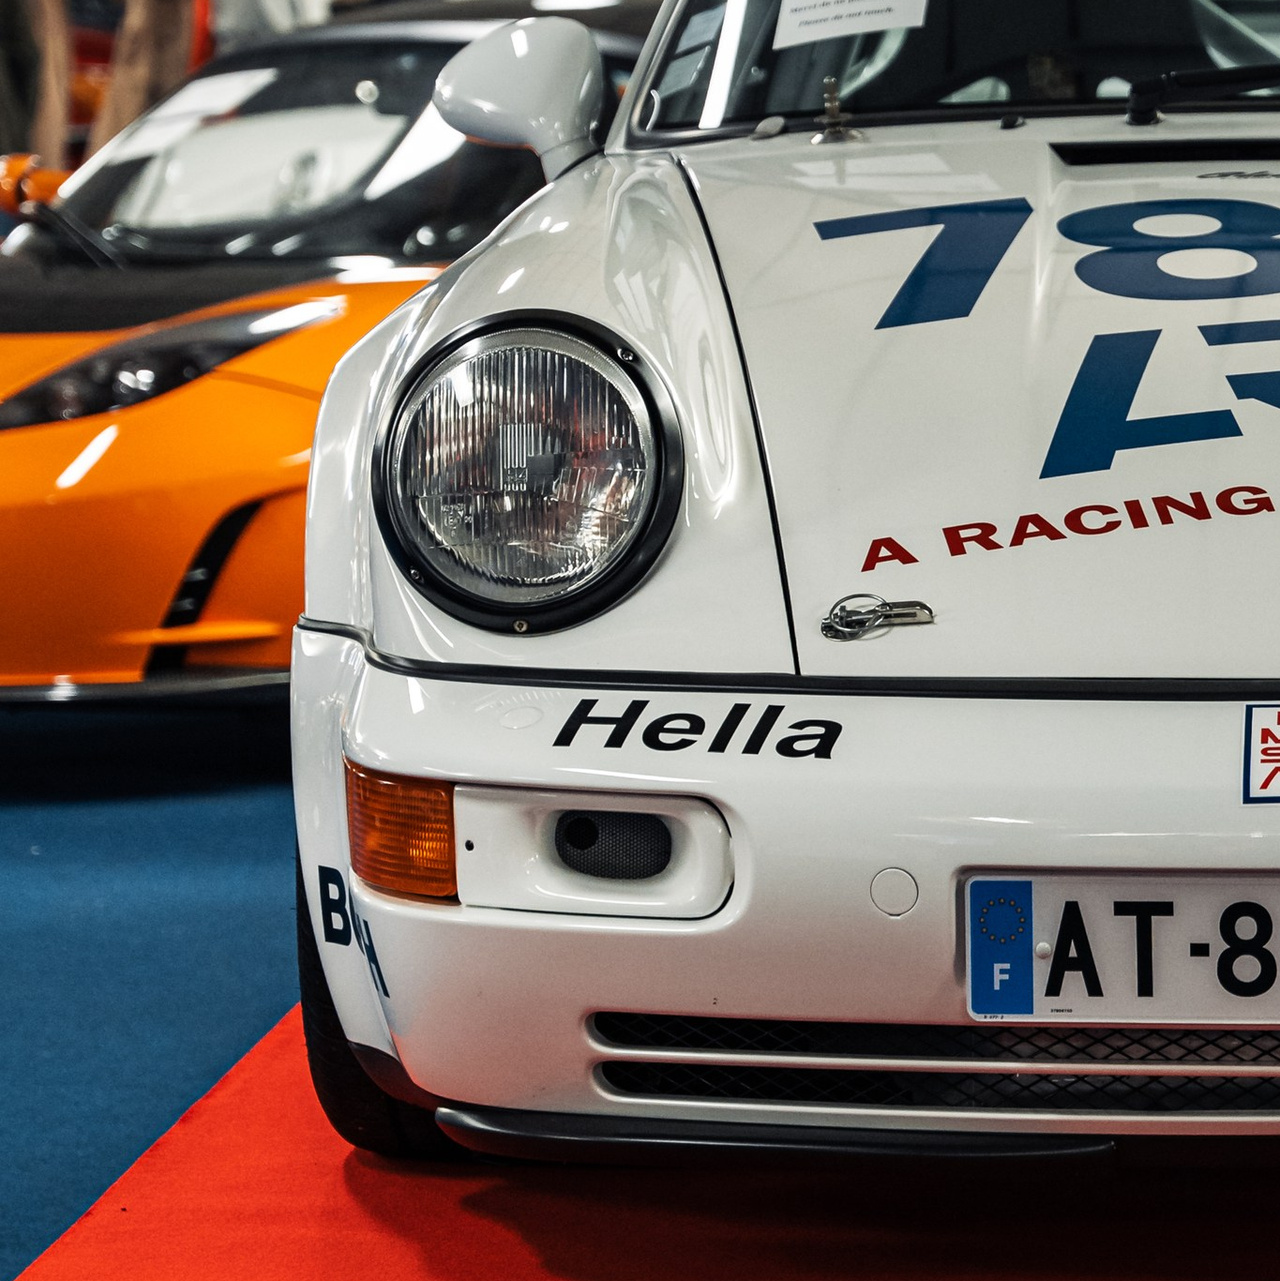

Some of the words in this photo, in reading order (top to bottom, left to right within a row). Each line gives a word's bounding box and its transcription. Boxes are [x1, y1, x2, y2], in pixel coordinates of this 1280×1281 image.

[860, 536, 920, 573] A
[941, 484, 1276, 557] RACING
[552, 698, 843, 760] Hella
[993, 963, 1011, 991] F
